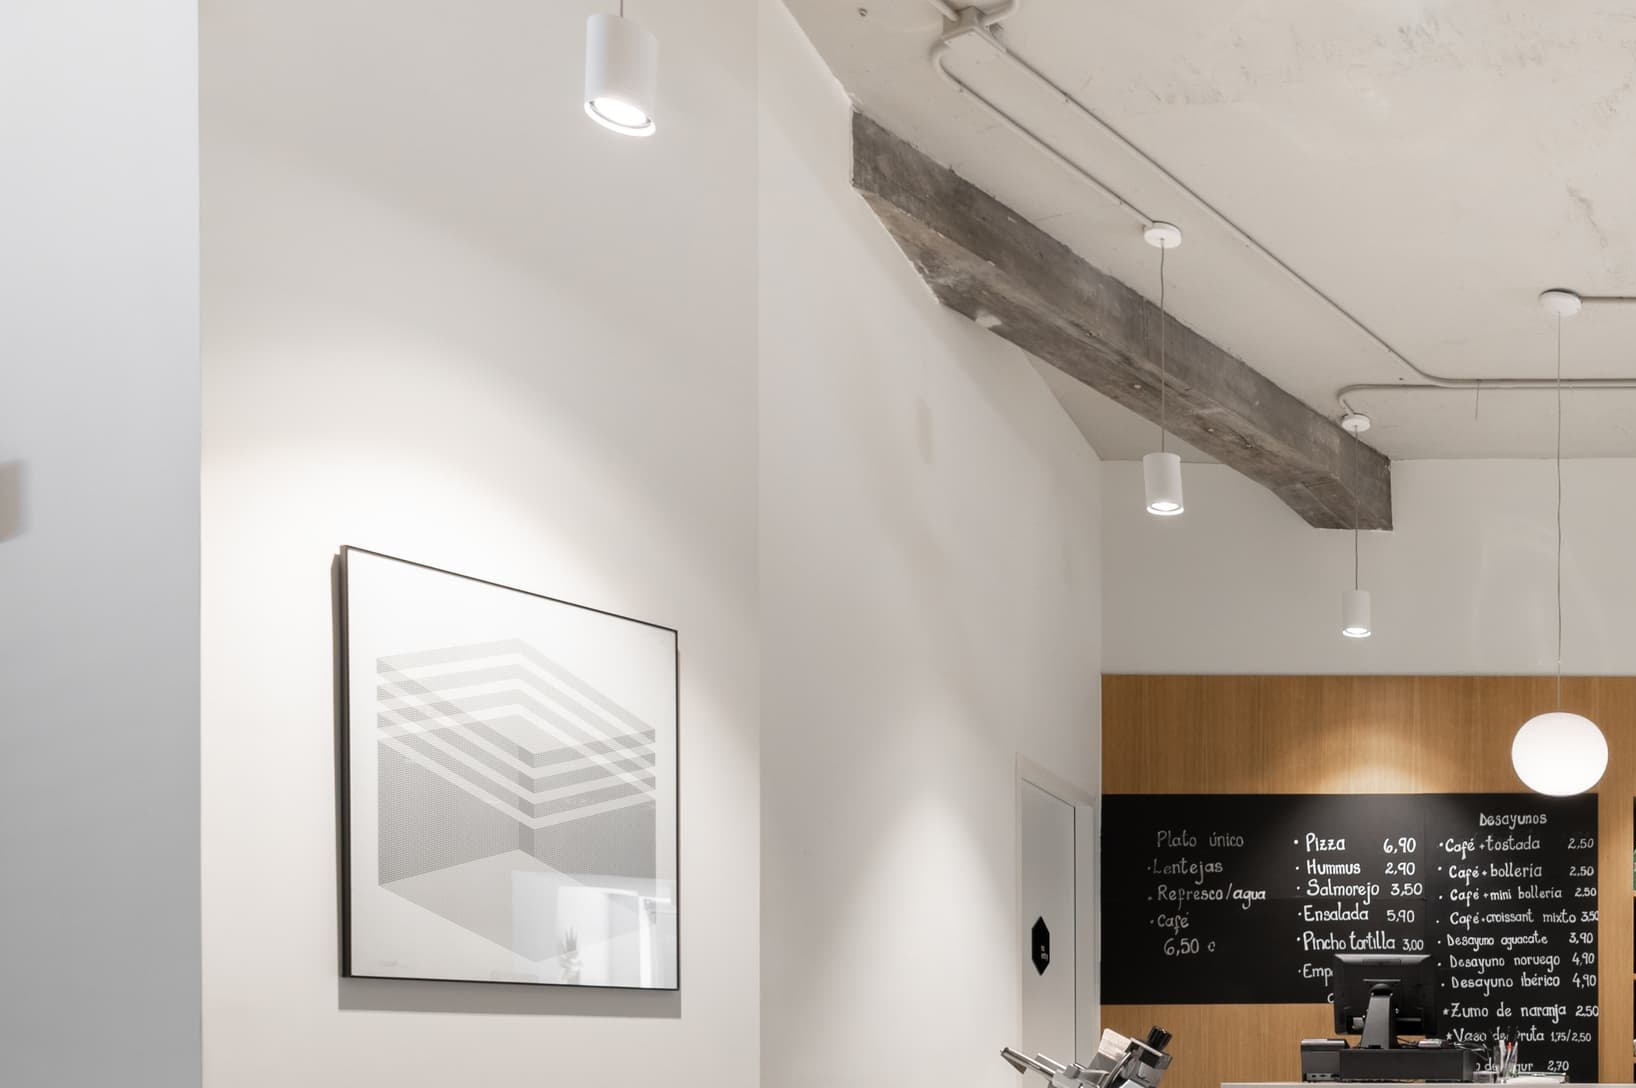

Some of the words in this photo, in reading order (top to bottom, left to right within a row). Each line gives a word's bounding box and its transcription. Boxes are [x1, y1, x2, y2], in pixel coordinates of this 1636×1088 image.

[1479, 812, 1548, 830] Desayunos
[1157, 829, 1197, 848] Plato
[1209, 832, 1244, 847] único
[1305, 832, 1346, 852] Pizza
[1383, 837, 1417, 854] 6,90
[1445, 838, 1475, 860] Café
[1153, 857, 1223, 885] Lentejas
[1306, 858, 1361, 875] Hummus
[1384, 861, 1416, 876] 2,90
[1306, 878, 1380, 906] Salmorejo
[1390, 882, 1423, 897] 3,50
[1450, 888, 1479, 907] Café
[1157, 911, 1189, 935] Café
[1303, 901, 1369, 921] Ensalada
[1386, 909, 1415, 923] 5,90
[1450, 911, 1479, 931] Café
[1543, 908, 1577, 923] mixto
[1163, 938, 1199, 956] 6,50
[1302, 930, 1346, 951] Pincho
[1348, 930, 1396, 950] tortilla
[1402, 938, 1424, 952] 3,00
[1446, 933, 1494, 952] Desayuno
[1500, 930, 1549, 950] aguacate
[1568, 932, 1594, 945] 3,90
[1450, 954, 1505, 974] Desayuno
[1513, 955, 1561, 973] noruego
[1571, 952, 1595, 967] 4,90
[1451, 976, 1513, 997] Desayuno
[1521, 971, 1560, 987] ibérico
[1572, 972, 1597, 989] 4,90
[1450, 1002, 1489, 1018] Zumo
[1496, 1001, 1512, 1017] de
[1521, 1004, 1566, 1024] naranja
[1453, 1027, 1487, 1042] Vaso
[1547, 1060, 1569, 1072] 2,70
